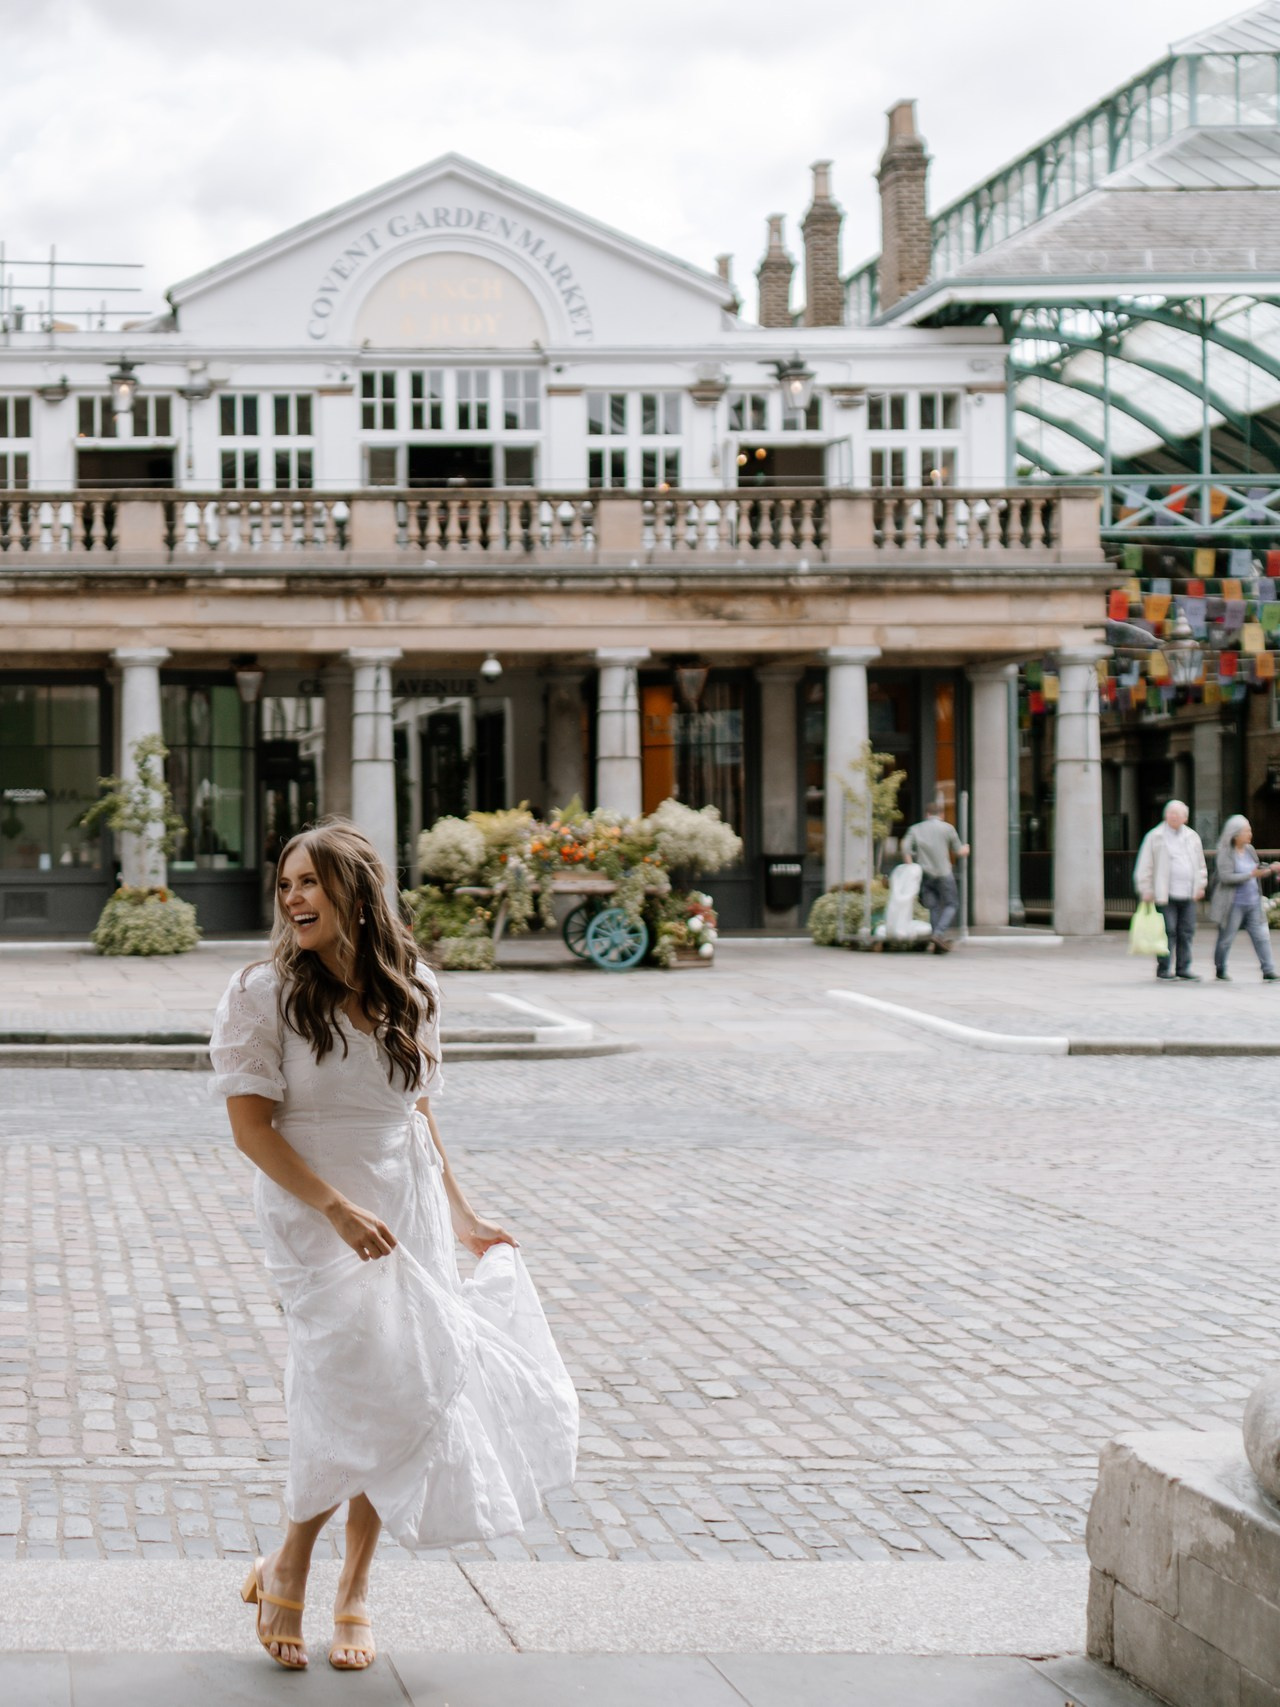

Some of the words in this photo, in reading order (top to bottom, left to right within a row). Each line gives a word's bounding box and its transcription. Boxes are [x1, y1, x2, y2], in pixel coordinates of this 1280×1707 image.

[307, 227, 382, 341] COVENT
[387, 206, 519, 239] GARDEN
[514, 228, 594, 342] MARKET
[399, 277, 503, 300] PUNCH
[423, 311, 503, 340] JUDY
[396, 678, 477, 694] AVENUE
